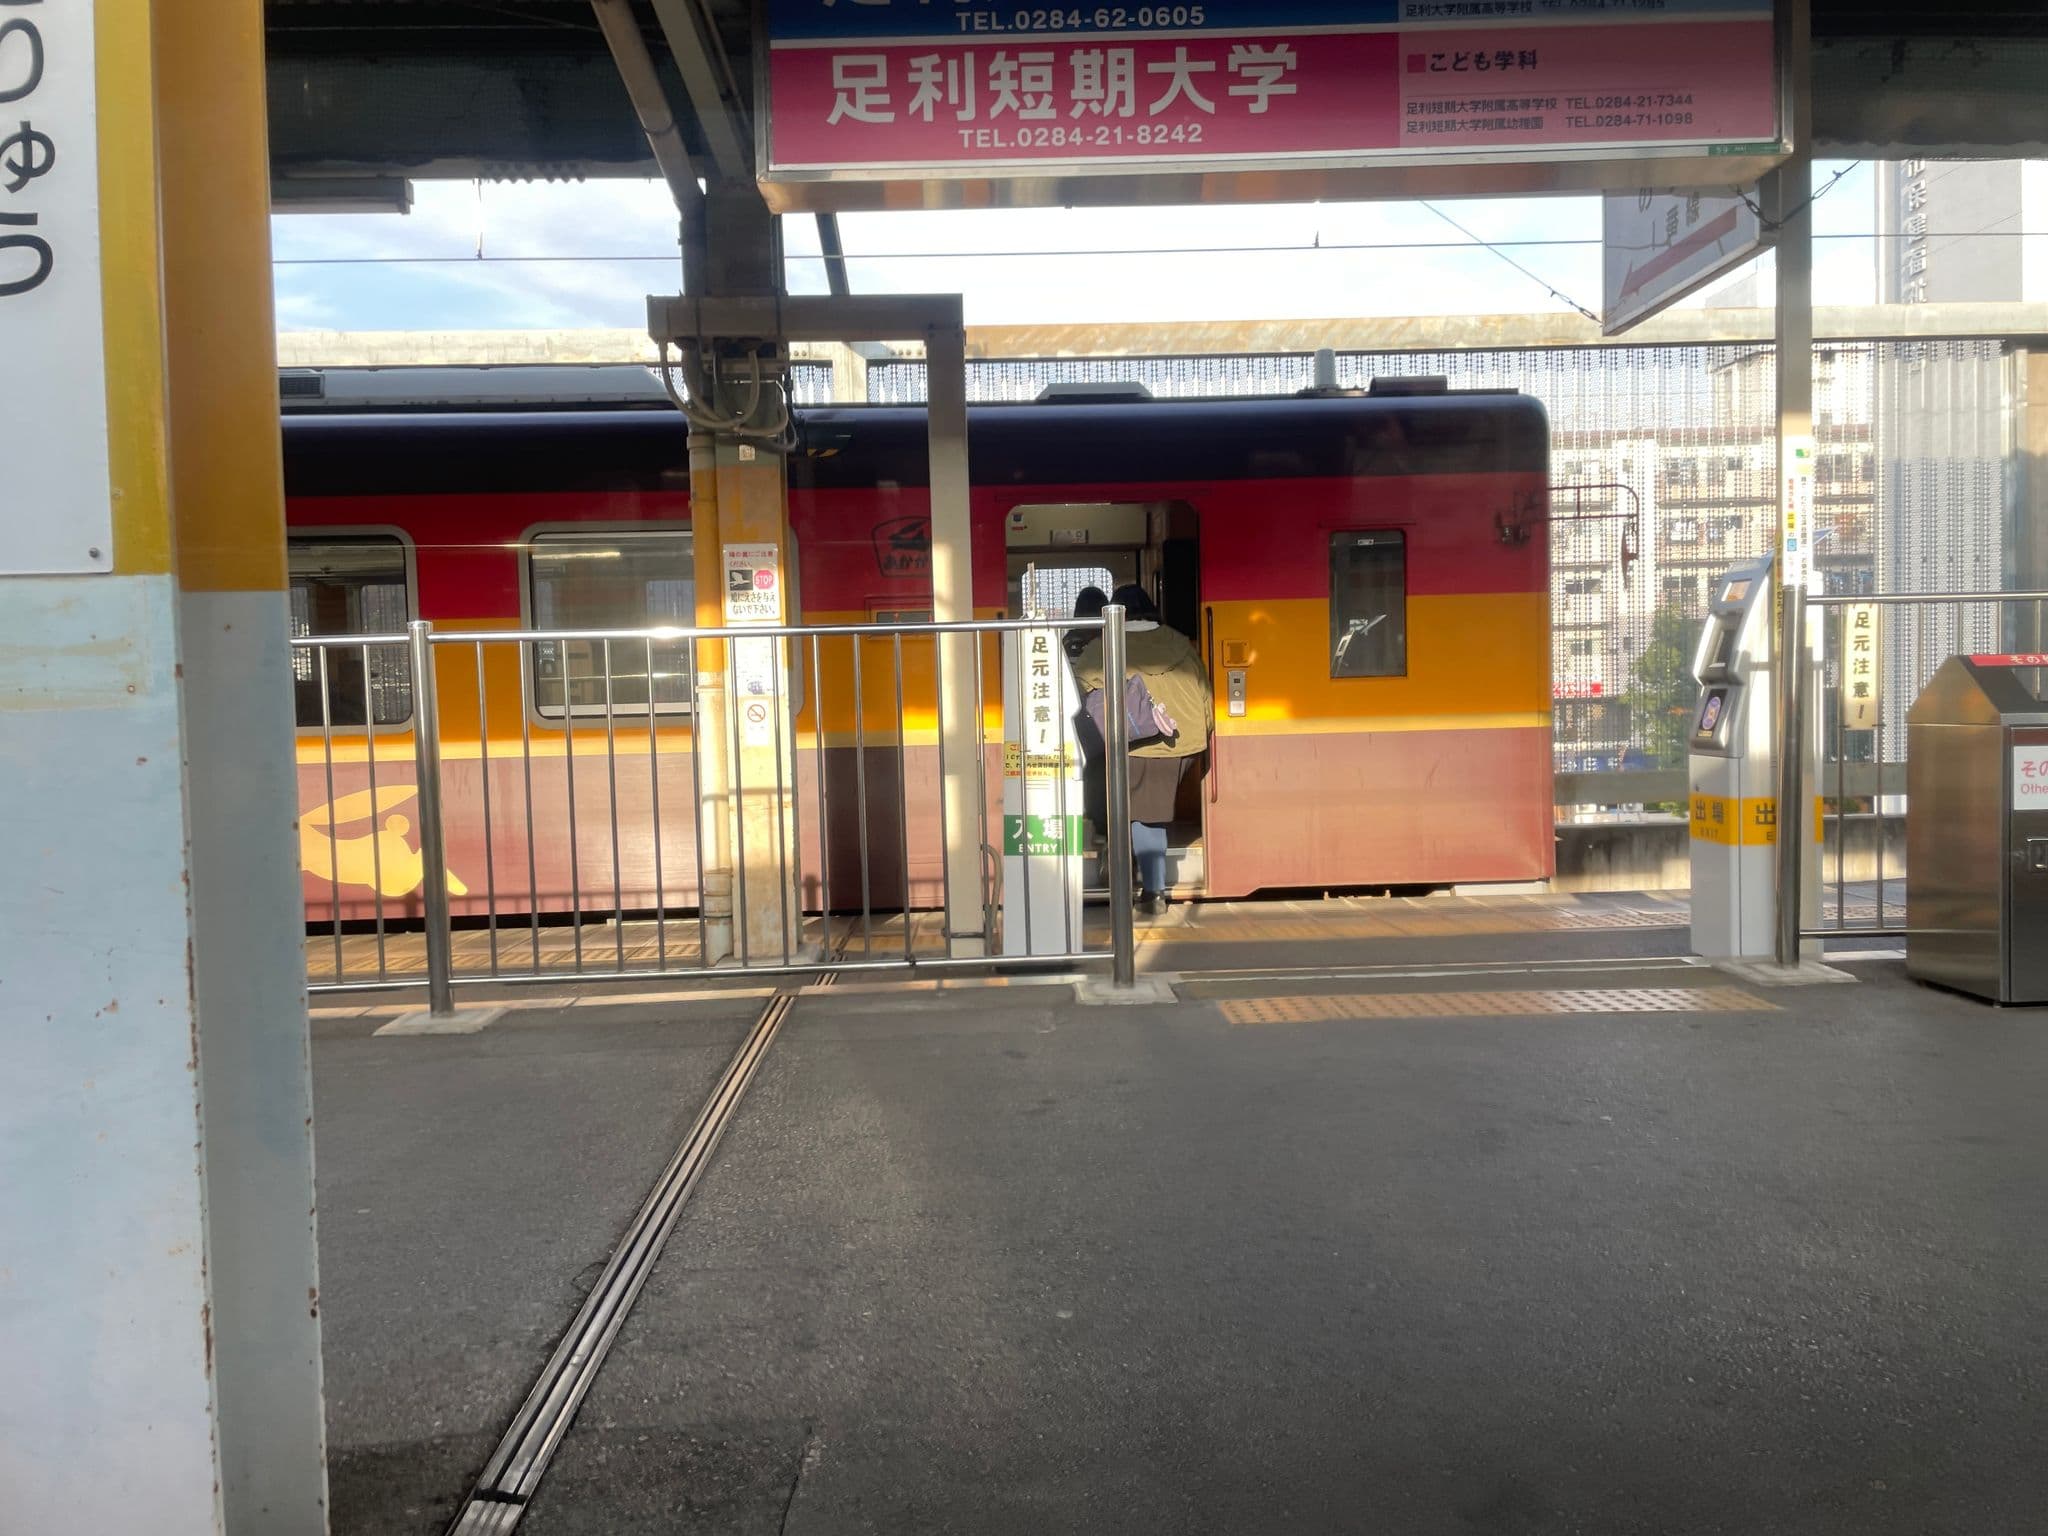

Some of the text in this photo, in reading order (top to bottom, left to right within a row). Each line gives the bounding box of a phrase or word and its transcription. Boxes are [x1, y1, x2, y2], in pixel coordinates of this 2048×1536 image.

[956, 6, 1205, 32] TEL.0284-62-0605
[1430, 49, 1538, 71] こども学科
[826, 43, 1298, 126] 足利短期大学
[1406, 93, 1694, 115] 足利短期大学附属高等学校 TEL.0284-21-7344
[1565, 112, 1693, 129] TEL.0284-71-1098
[958, 123, 1203, 150] TEL.0284-21-8242
[755, 575, 773, 585] STOP
[1695, 798, 1724, 825] 出場
[1018, 842, 1058, 854] ENTRY
